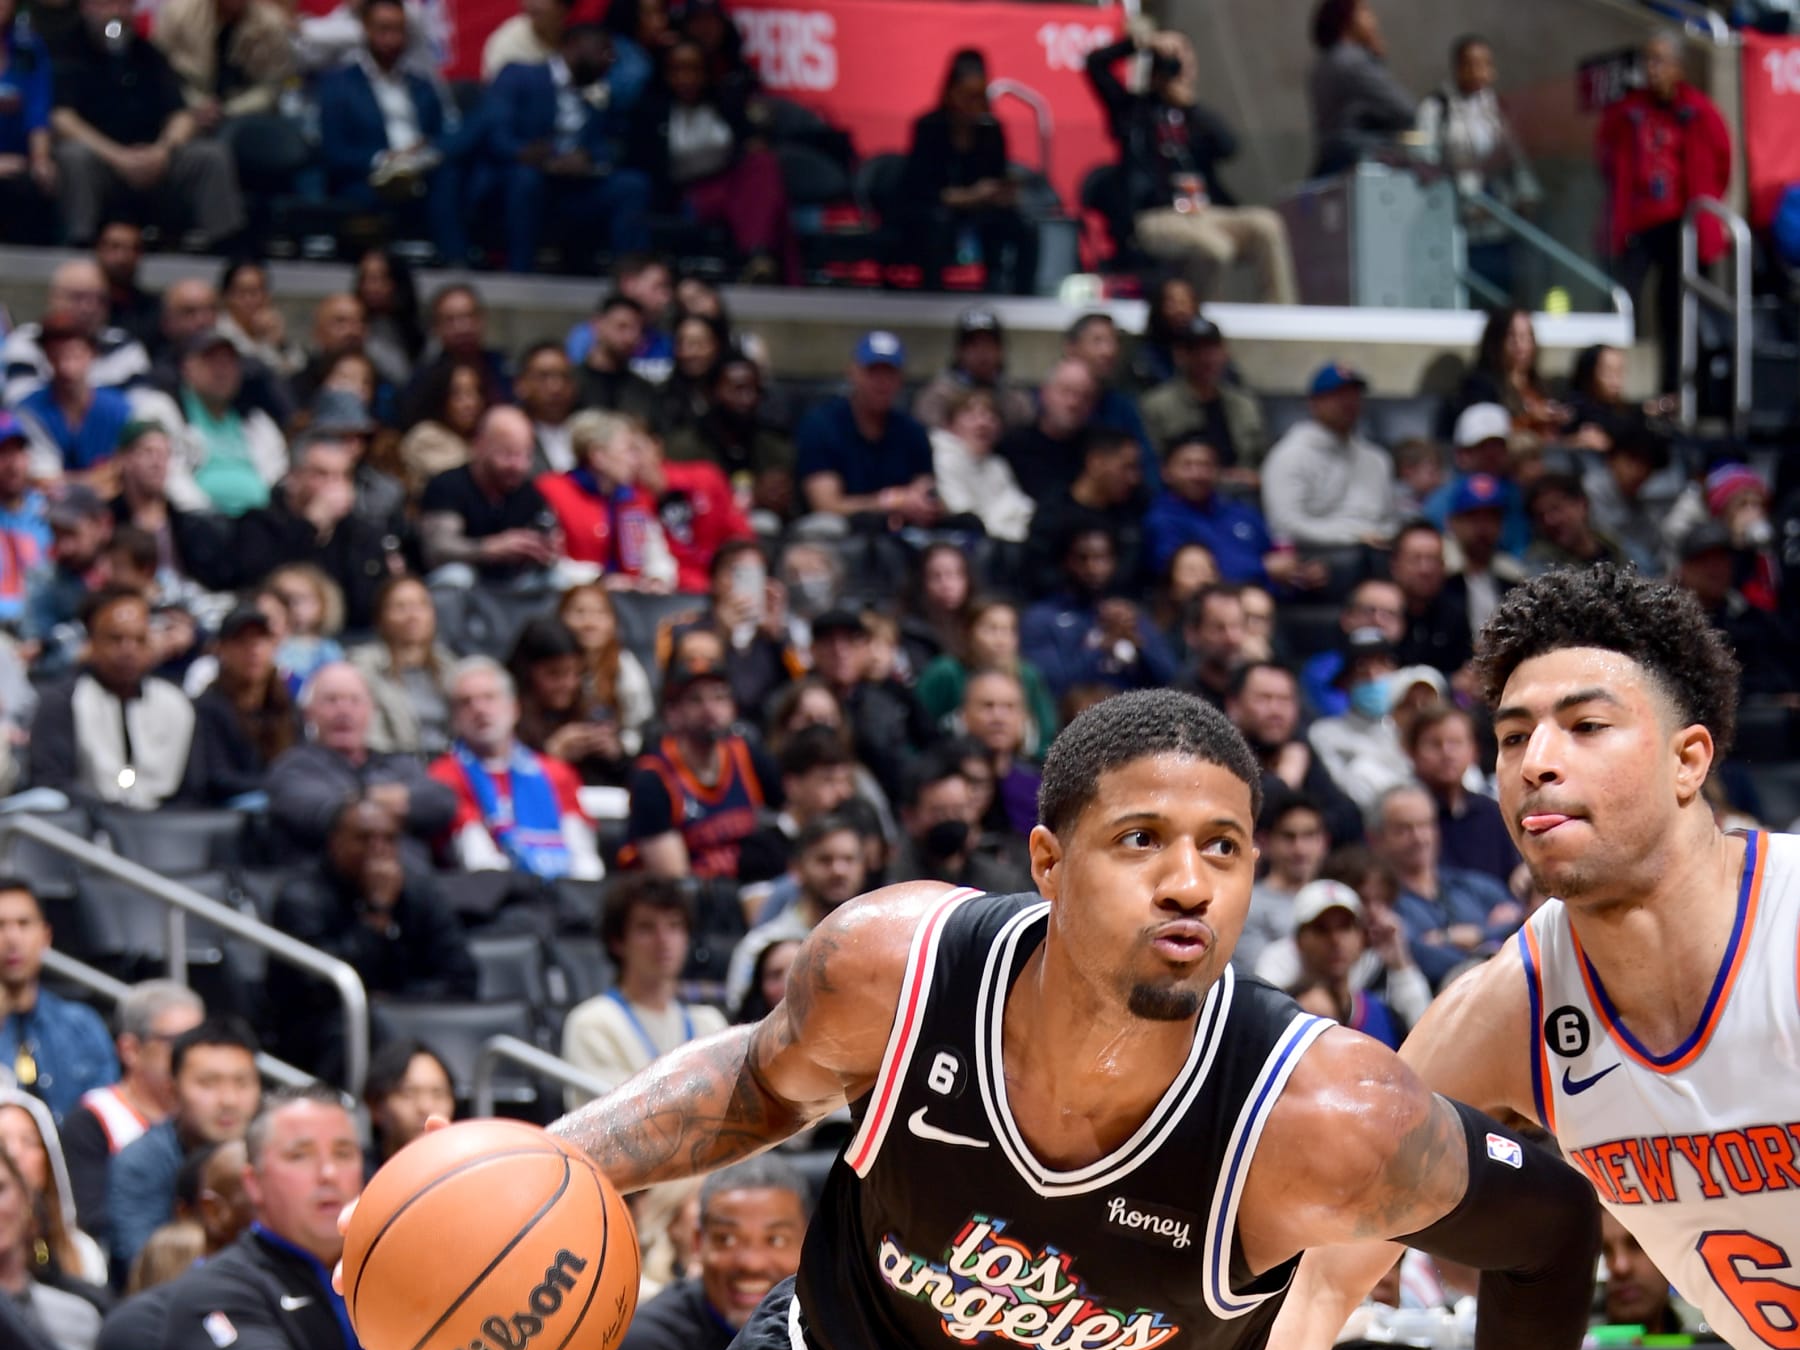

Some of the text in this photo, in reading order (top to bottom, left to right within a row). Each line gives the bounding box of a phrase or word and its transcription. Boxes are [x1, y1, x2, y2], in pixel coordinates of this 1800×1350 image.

[1556, 1013, 1582, 1051] 6
[927, 1051, 959, 1095] 6
[1570, 1136, 1679, 1204] NEW
[1107, 1197, 1191, 1249] honey
[948, 1217, 1080, 1303] los
